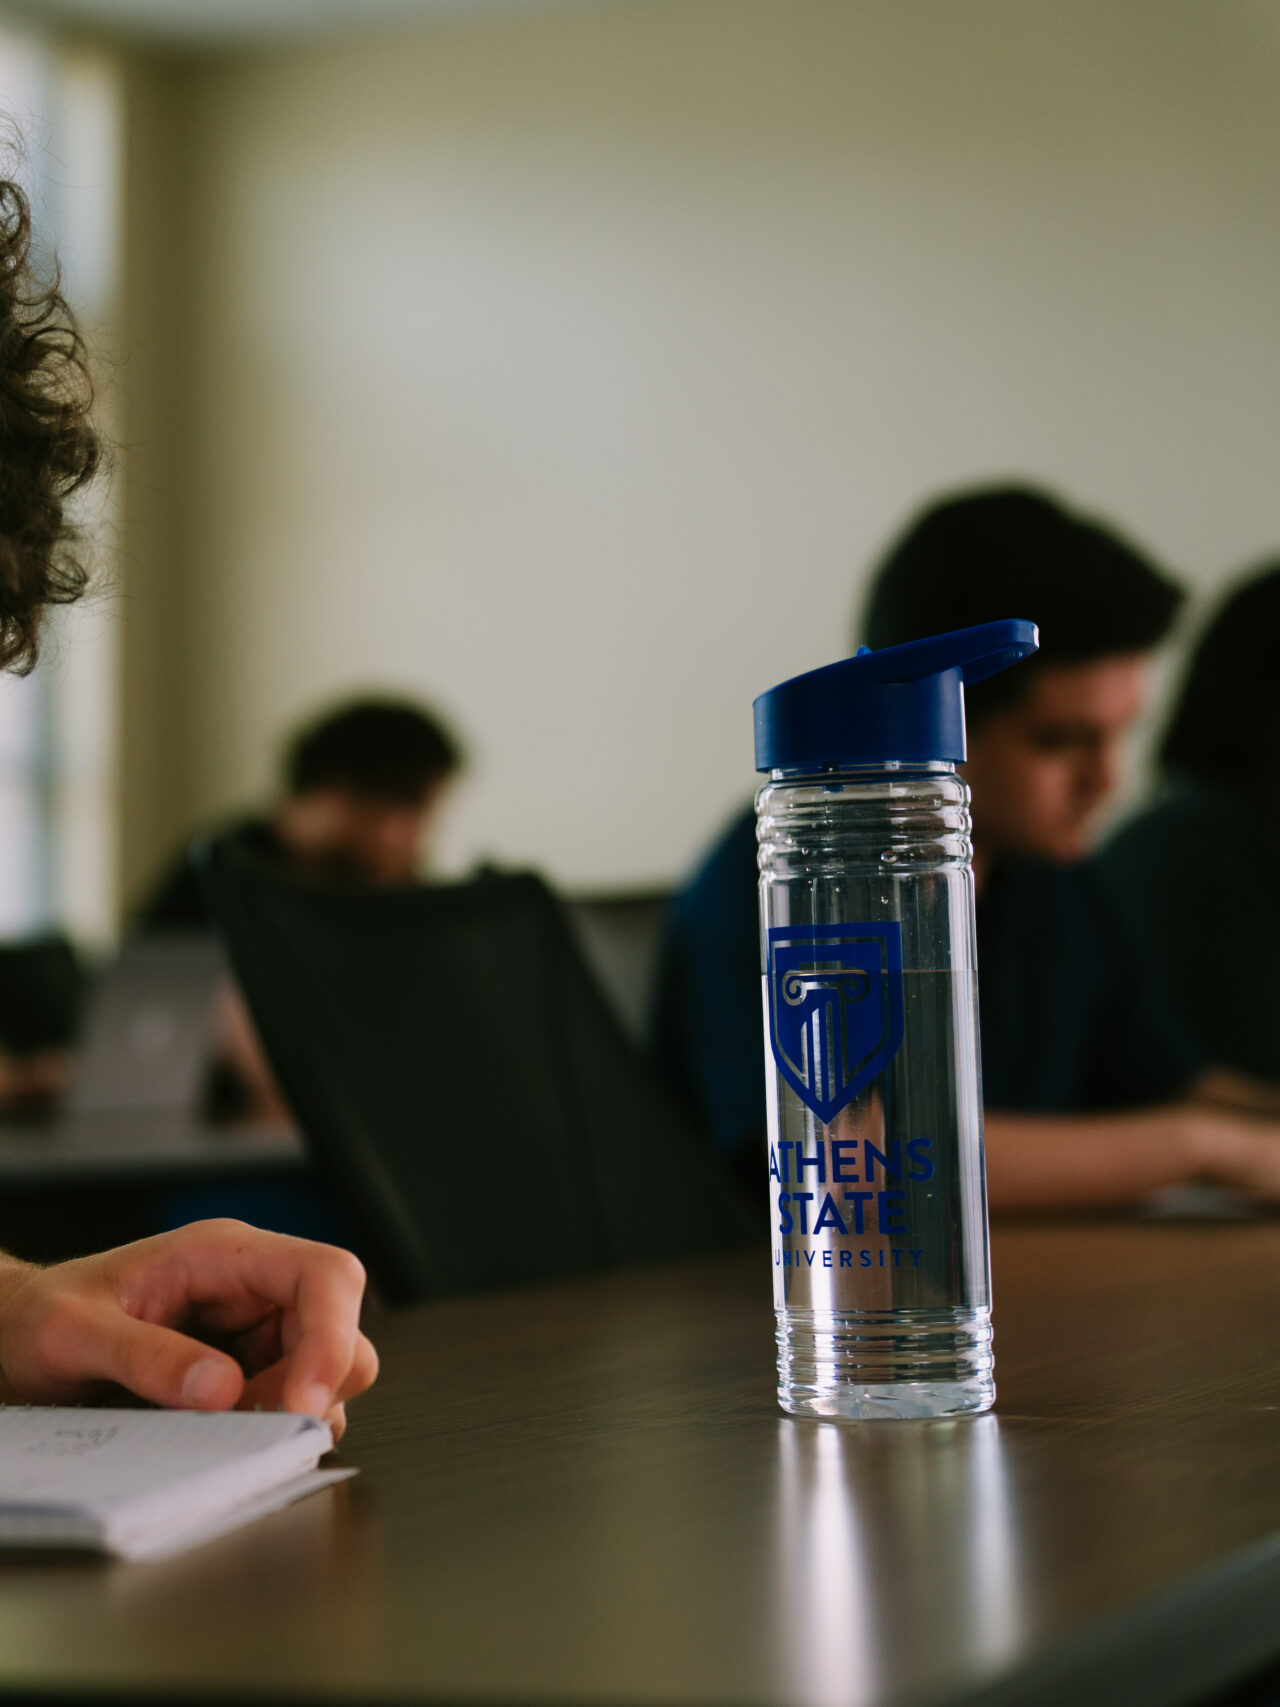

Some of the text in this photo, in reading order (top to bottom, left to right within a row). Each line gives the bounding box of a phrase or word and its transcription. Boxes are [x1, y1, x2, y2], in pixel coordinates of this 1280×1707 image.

[770, 1138, 935, 1183] ATHENS
[778, 1191, 907, 1235] STATE
[775, 1249, 923, 1268] UNIVERSITY
